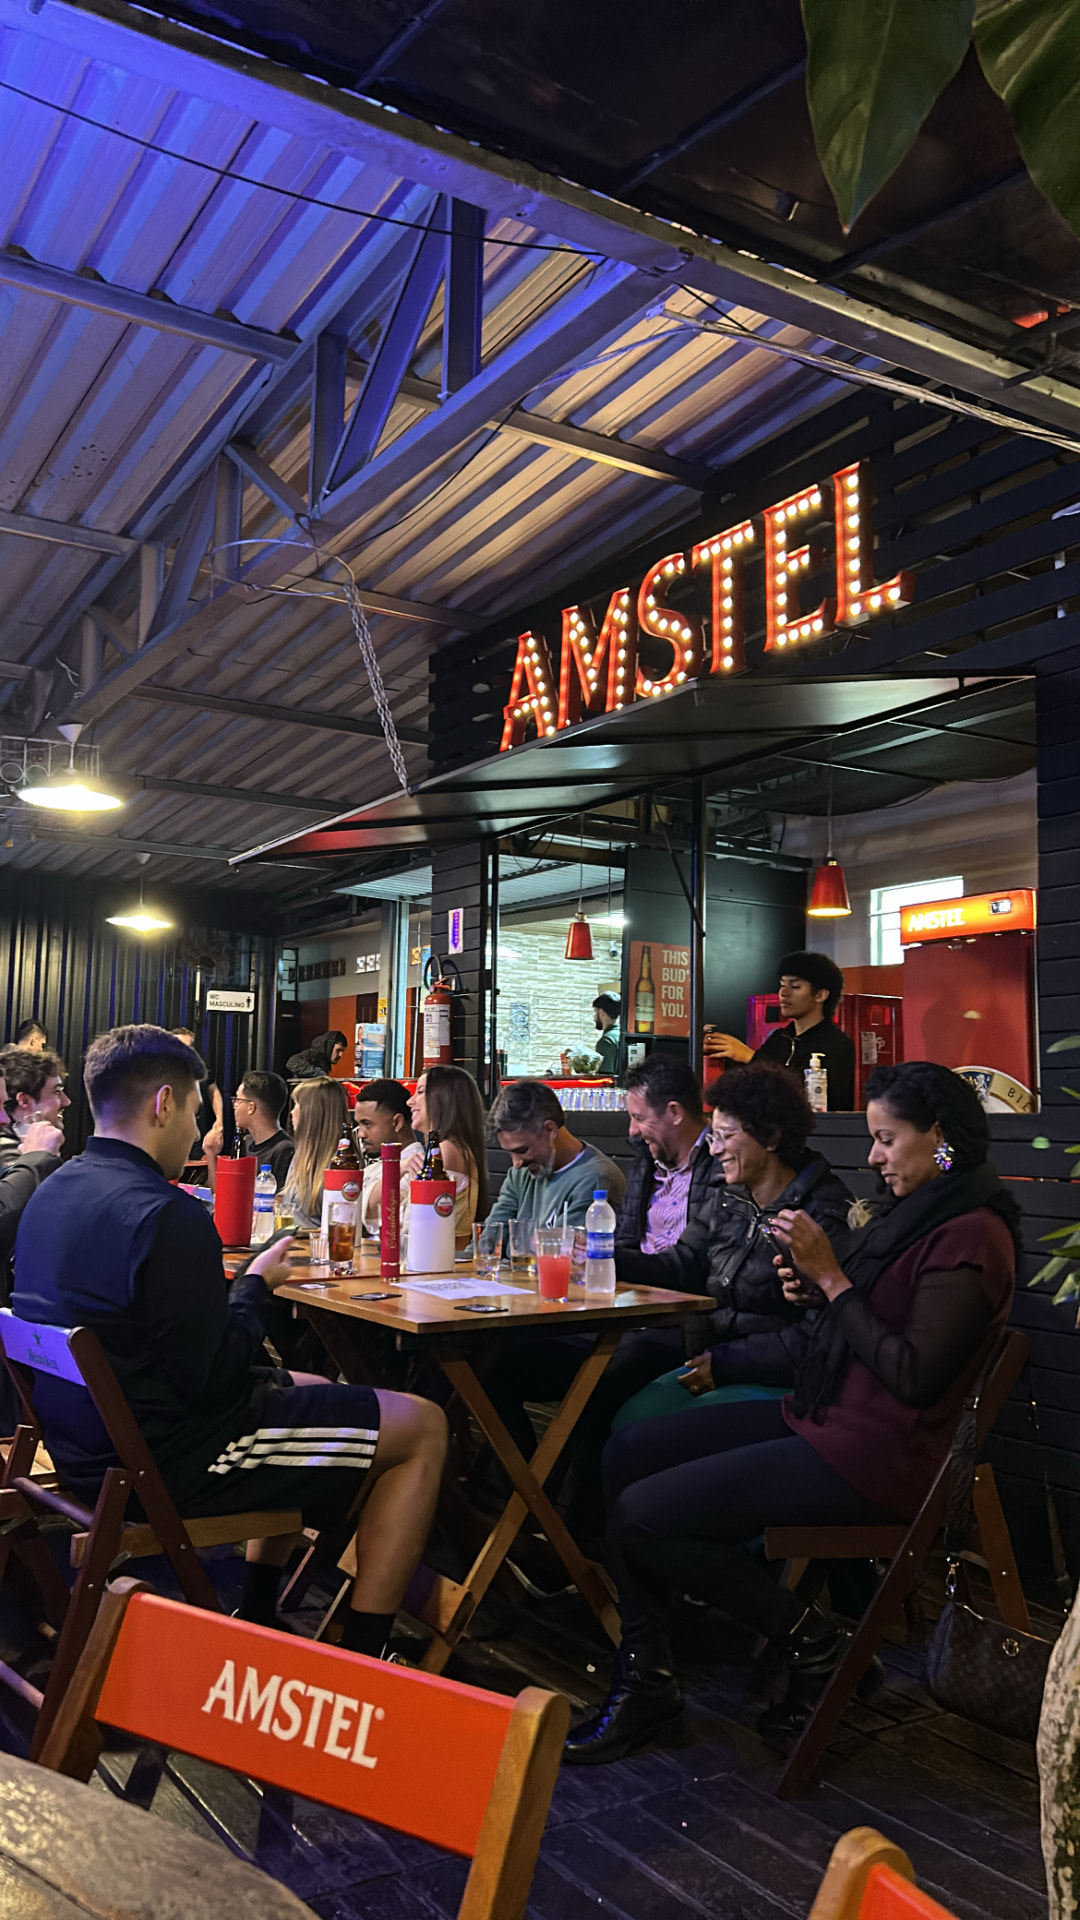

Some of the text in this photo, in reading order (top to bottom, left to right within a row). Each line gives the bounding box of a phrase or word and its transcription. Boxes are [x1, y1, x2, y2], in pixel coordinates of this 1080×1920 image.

[499, 461, 912, 752] AMSTEL
[907, 908, 965, 932] AMSTEL
[662, 949, 689, 966] THIS
[662, 967, 691, 983] BUD'
[661, 984, 684, 1001] FOR
[209, 1001, 246, 1009] MASCULINO
[661, 1002, 688, 1018] YOU.
[201, 1659, 380, 1769] AMSTEL
